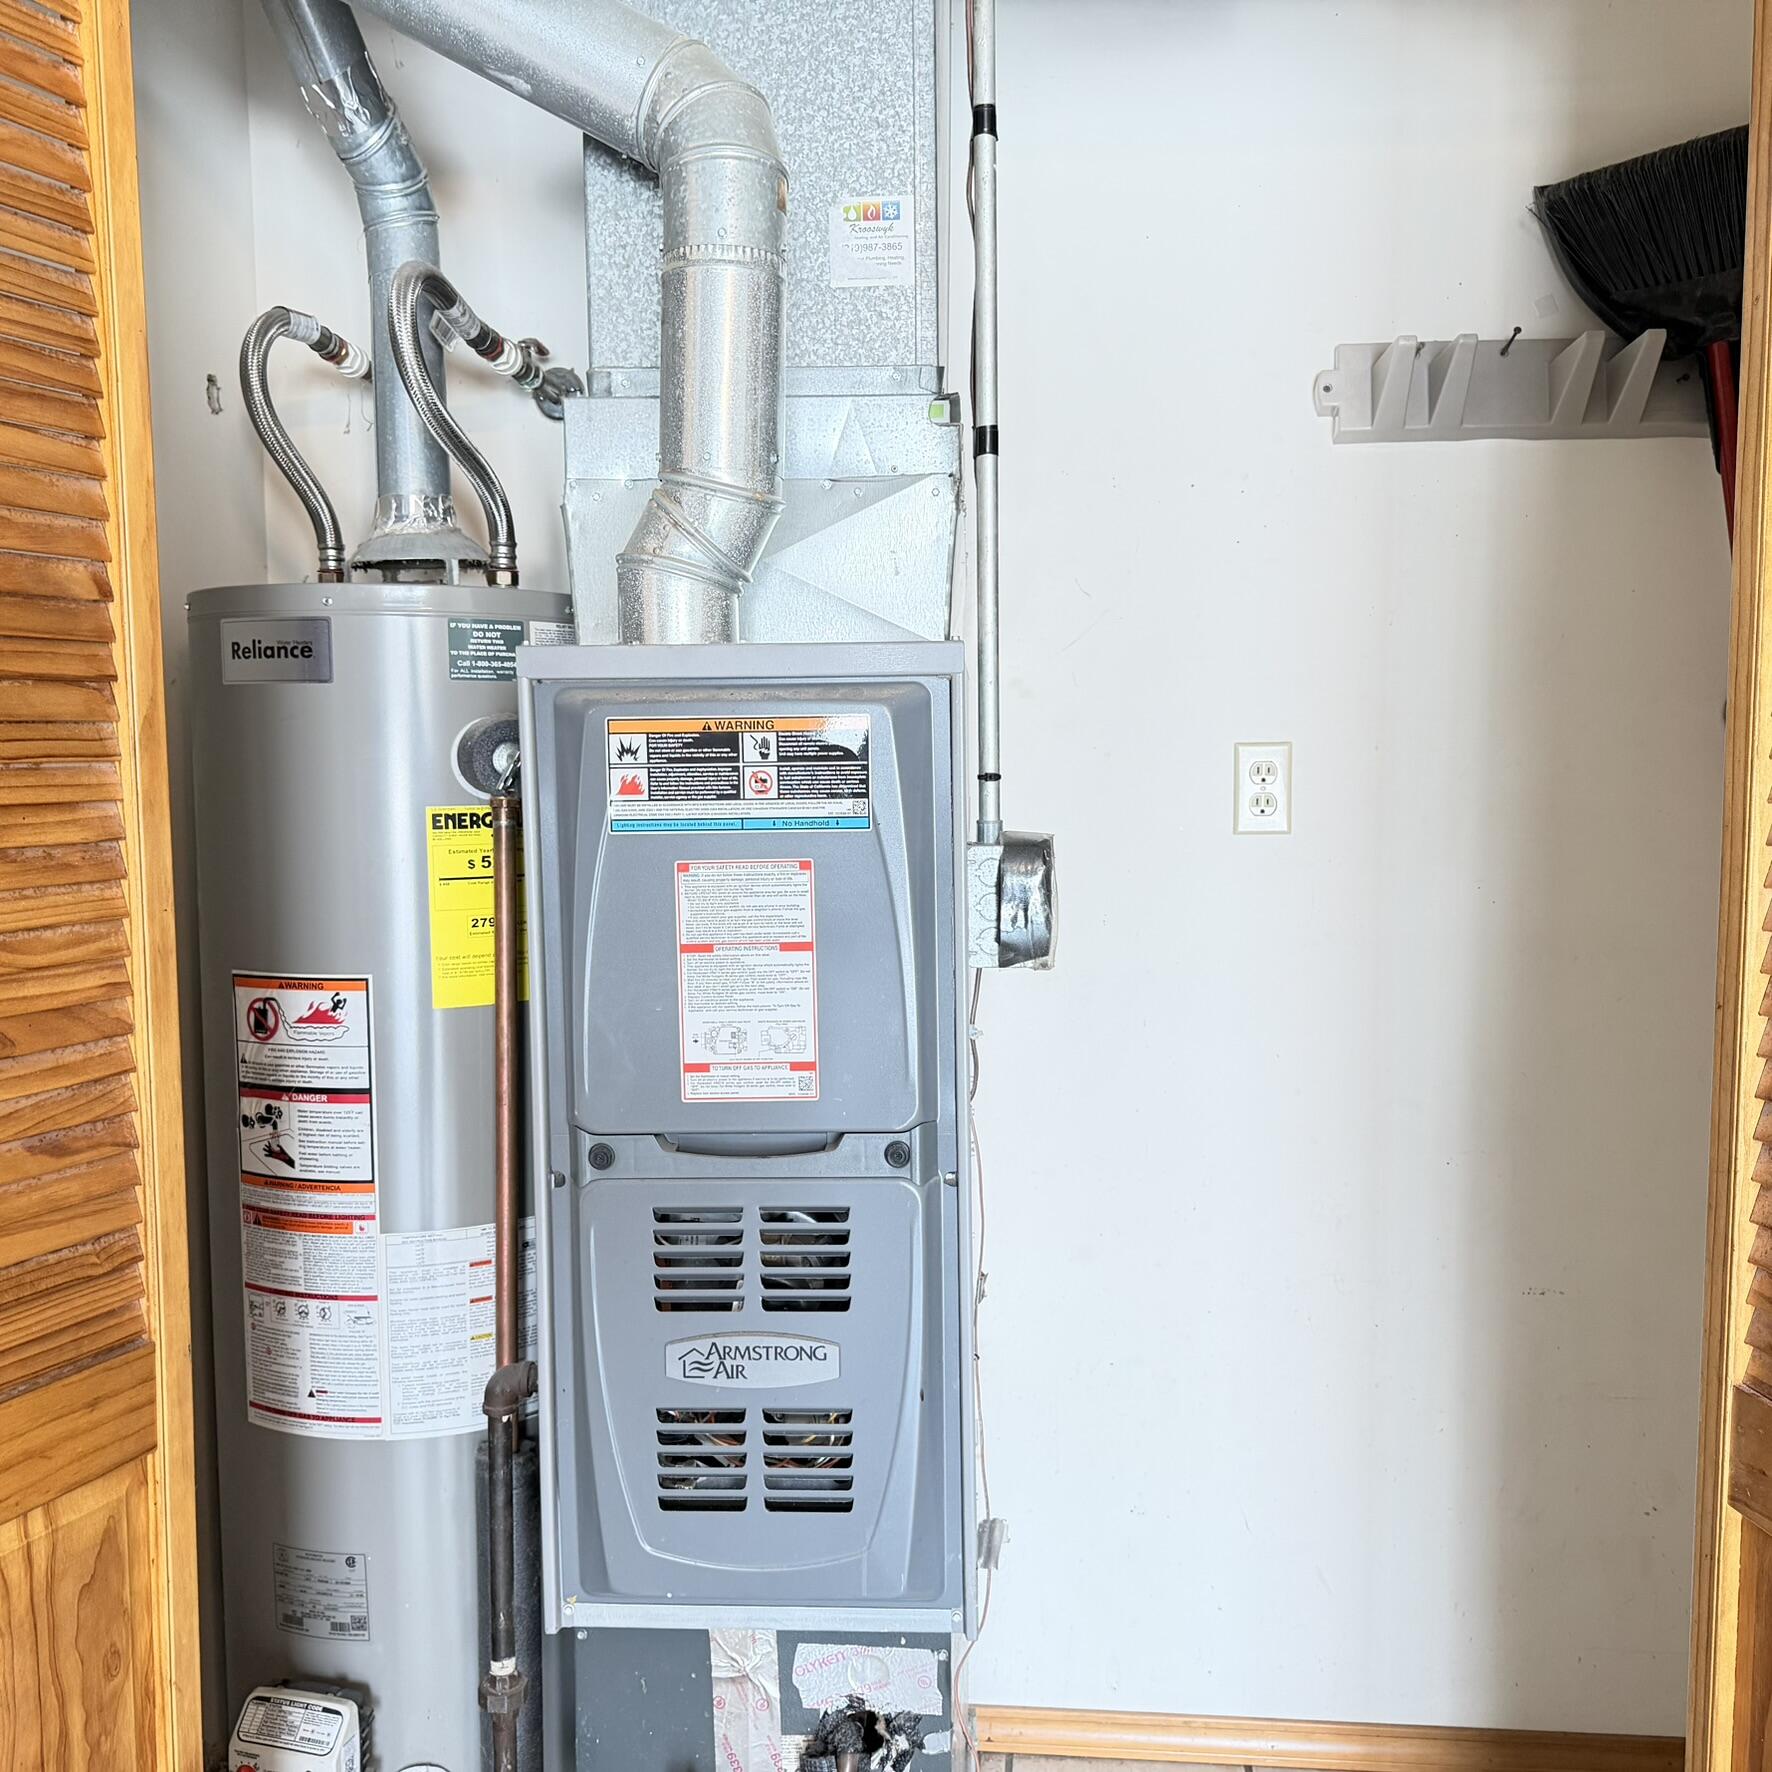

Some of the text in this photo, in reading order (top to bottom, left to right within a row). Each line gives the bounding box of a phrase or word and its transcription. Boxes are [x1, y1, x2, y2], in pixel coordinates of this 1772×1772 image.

[232, 640, 312, 660] Reliance
[714, 720, 774, 731] WARNING
[284, 982, 324, 990] WARNING
[292, 1093, 328, 1102] DANGER
[705, 1342, 827, 1361] ARMSTRONG
[712, 1361, 748, 1379] AIR
